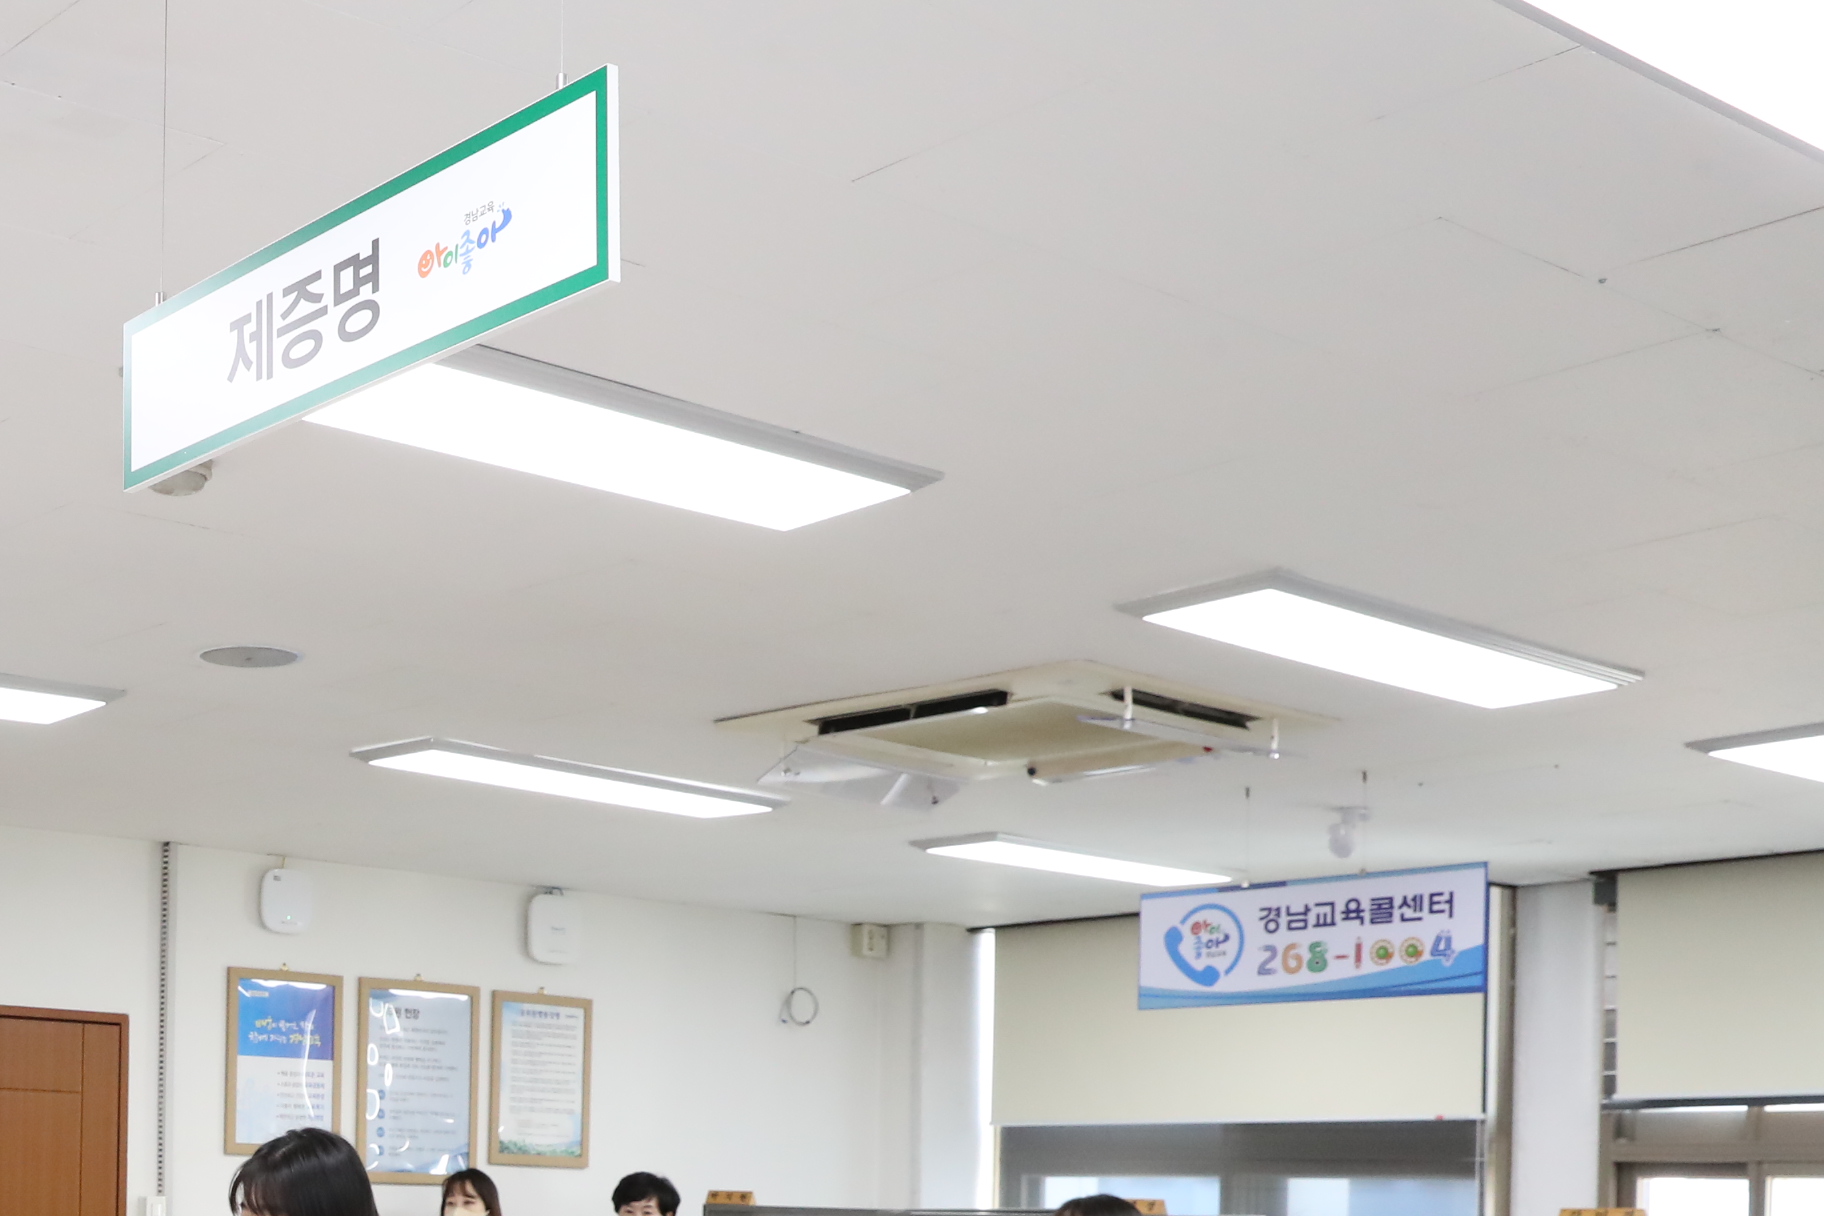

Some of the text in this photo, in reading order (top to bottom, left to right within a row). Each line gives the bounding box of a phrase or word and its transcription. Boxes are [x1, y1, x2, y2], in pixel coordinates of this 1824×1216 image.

[464, 201, 494, 225] 경남교육
[226, 205, 512, 383] 제증명 아이좋아
[1258, 891, 1454, 934] 경남교육콜센터
[1257, 930, 1456, 977] 268-1004
